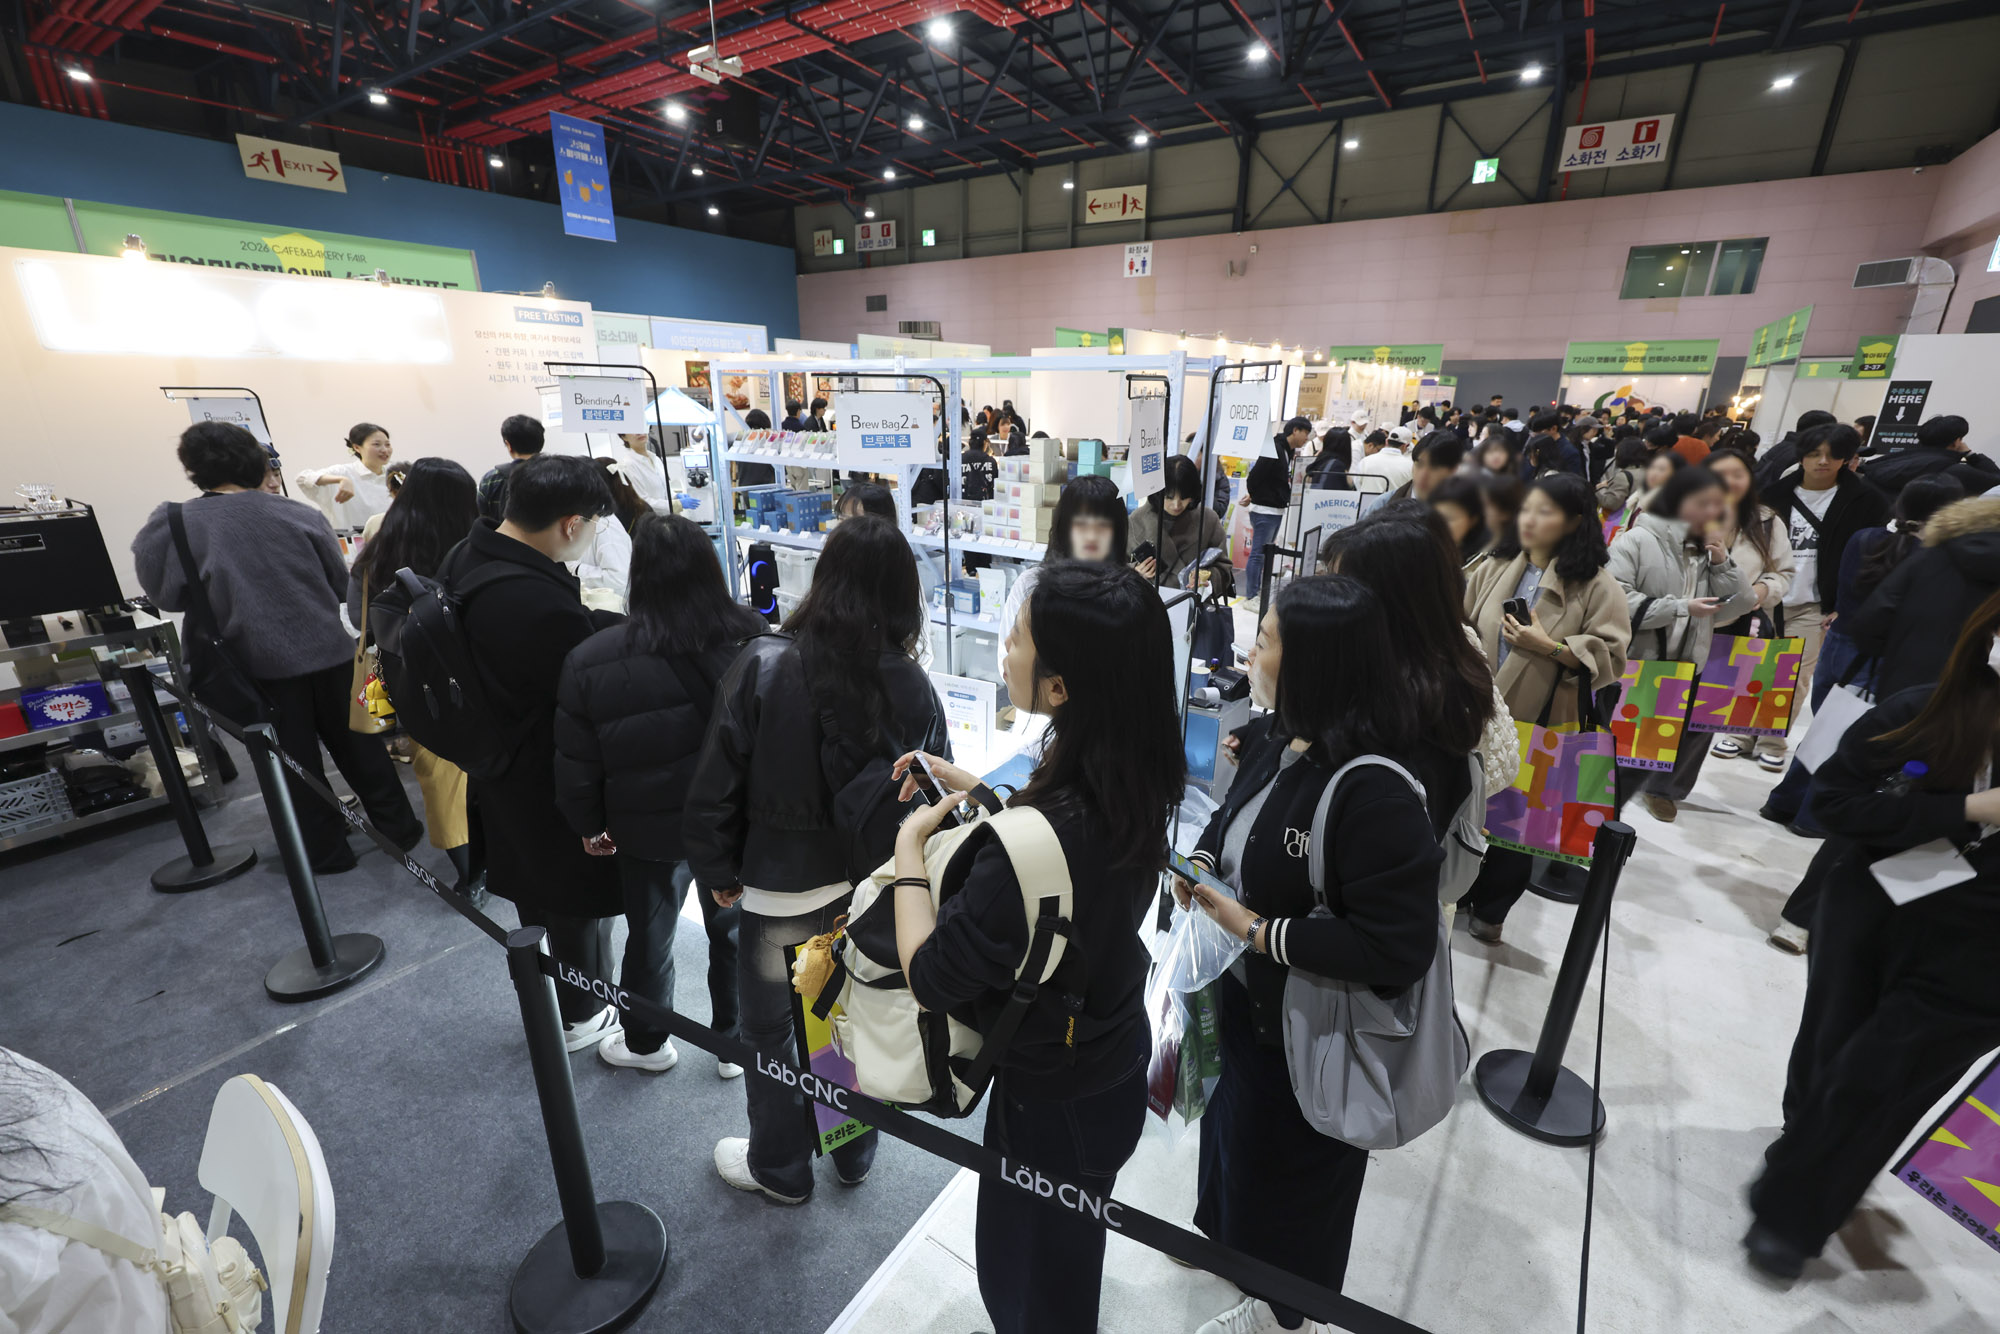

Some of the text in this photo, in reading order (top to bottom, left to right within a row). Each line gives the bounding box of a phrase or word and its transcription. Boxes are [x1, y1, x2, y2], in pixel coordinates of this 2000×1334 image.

[1564, 143, 1660, 167] 소화전 소화기
[283, 160, 314, 172] EXIT
[1103, 201, 1122, 210] EXIT
[857, 238, 894, 249] 소화전 소화기
[1128, 245, 1150, 254] 화장실
[240, 240, 367, 264] 2026 CAFE&BAKERY FAIR
[518, 310, 580, 324] FREE TASTING
[498, 331, 512, 340] 커피
[574, 392, 622, 407] Blending4
[1888, 395, 1923, 404] HERE
[585, 410, 622, 420] 블렌딩 존
[1230, 404, 1259, 421] ORDER
[851, 414, 910, 432] Brew Bag2
[864, 435, 909, 447] 브루백 존
[48, 700, 86, 712] 박카스
[67, 710, 75, 718] F
[825, 1122, 856, 1146] 우리는
[1907, 1170, 1948, 1207] 우리는
